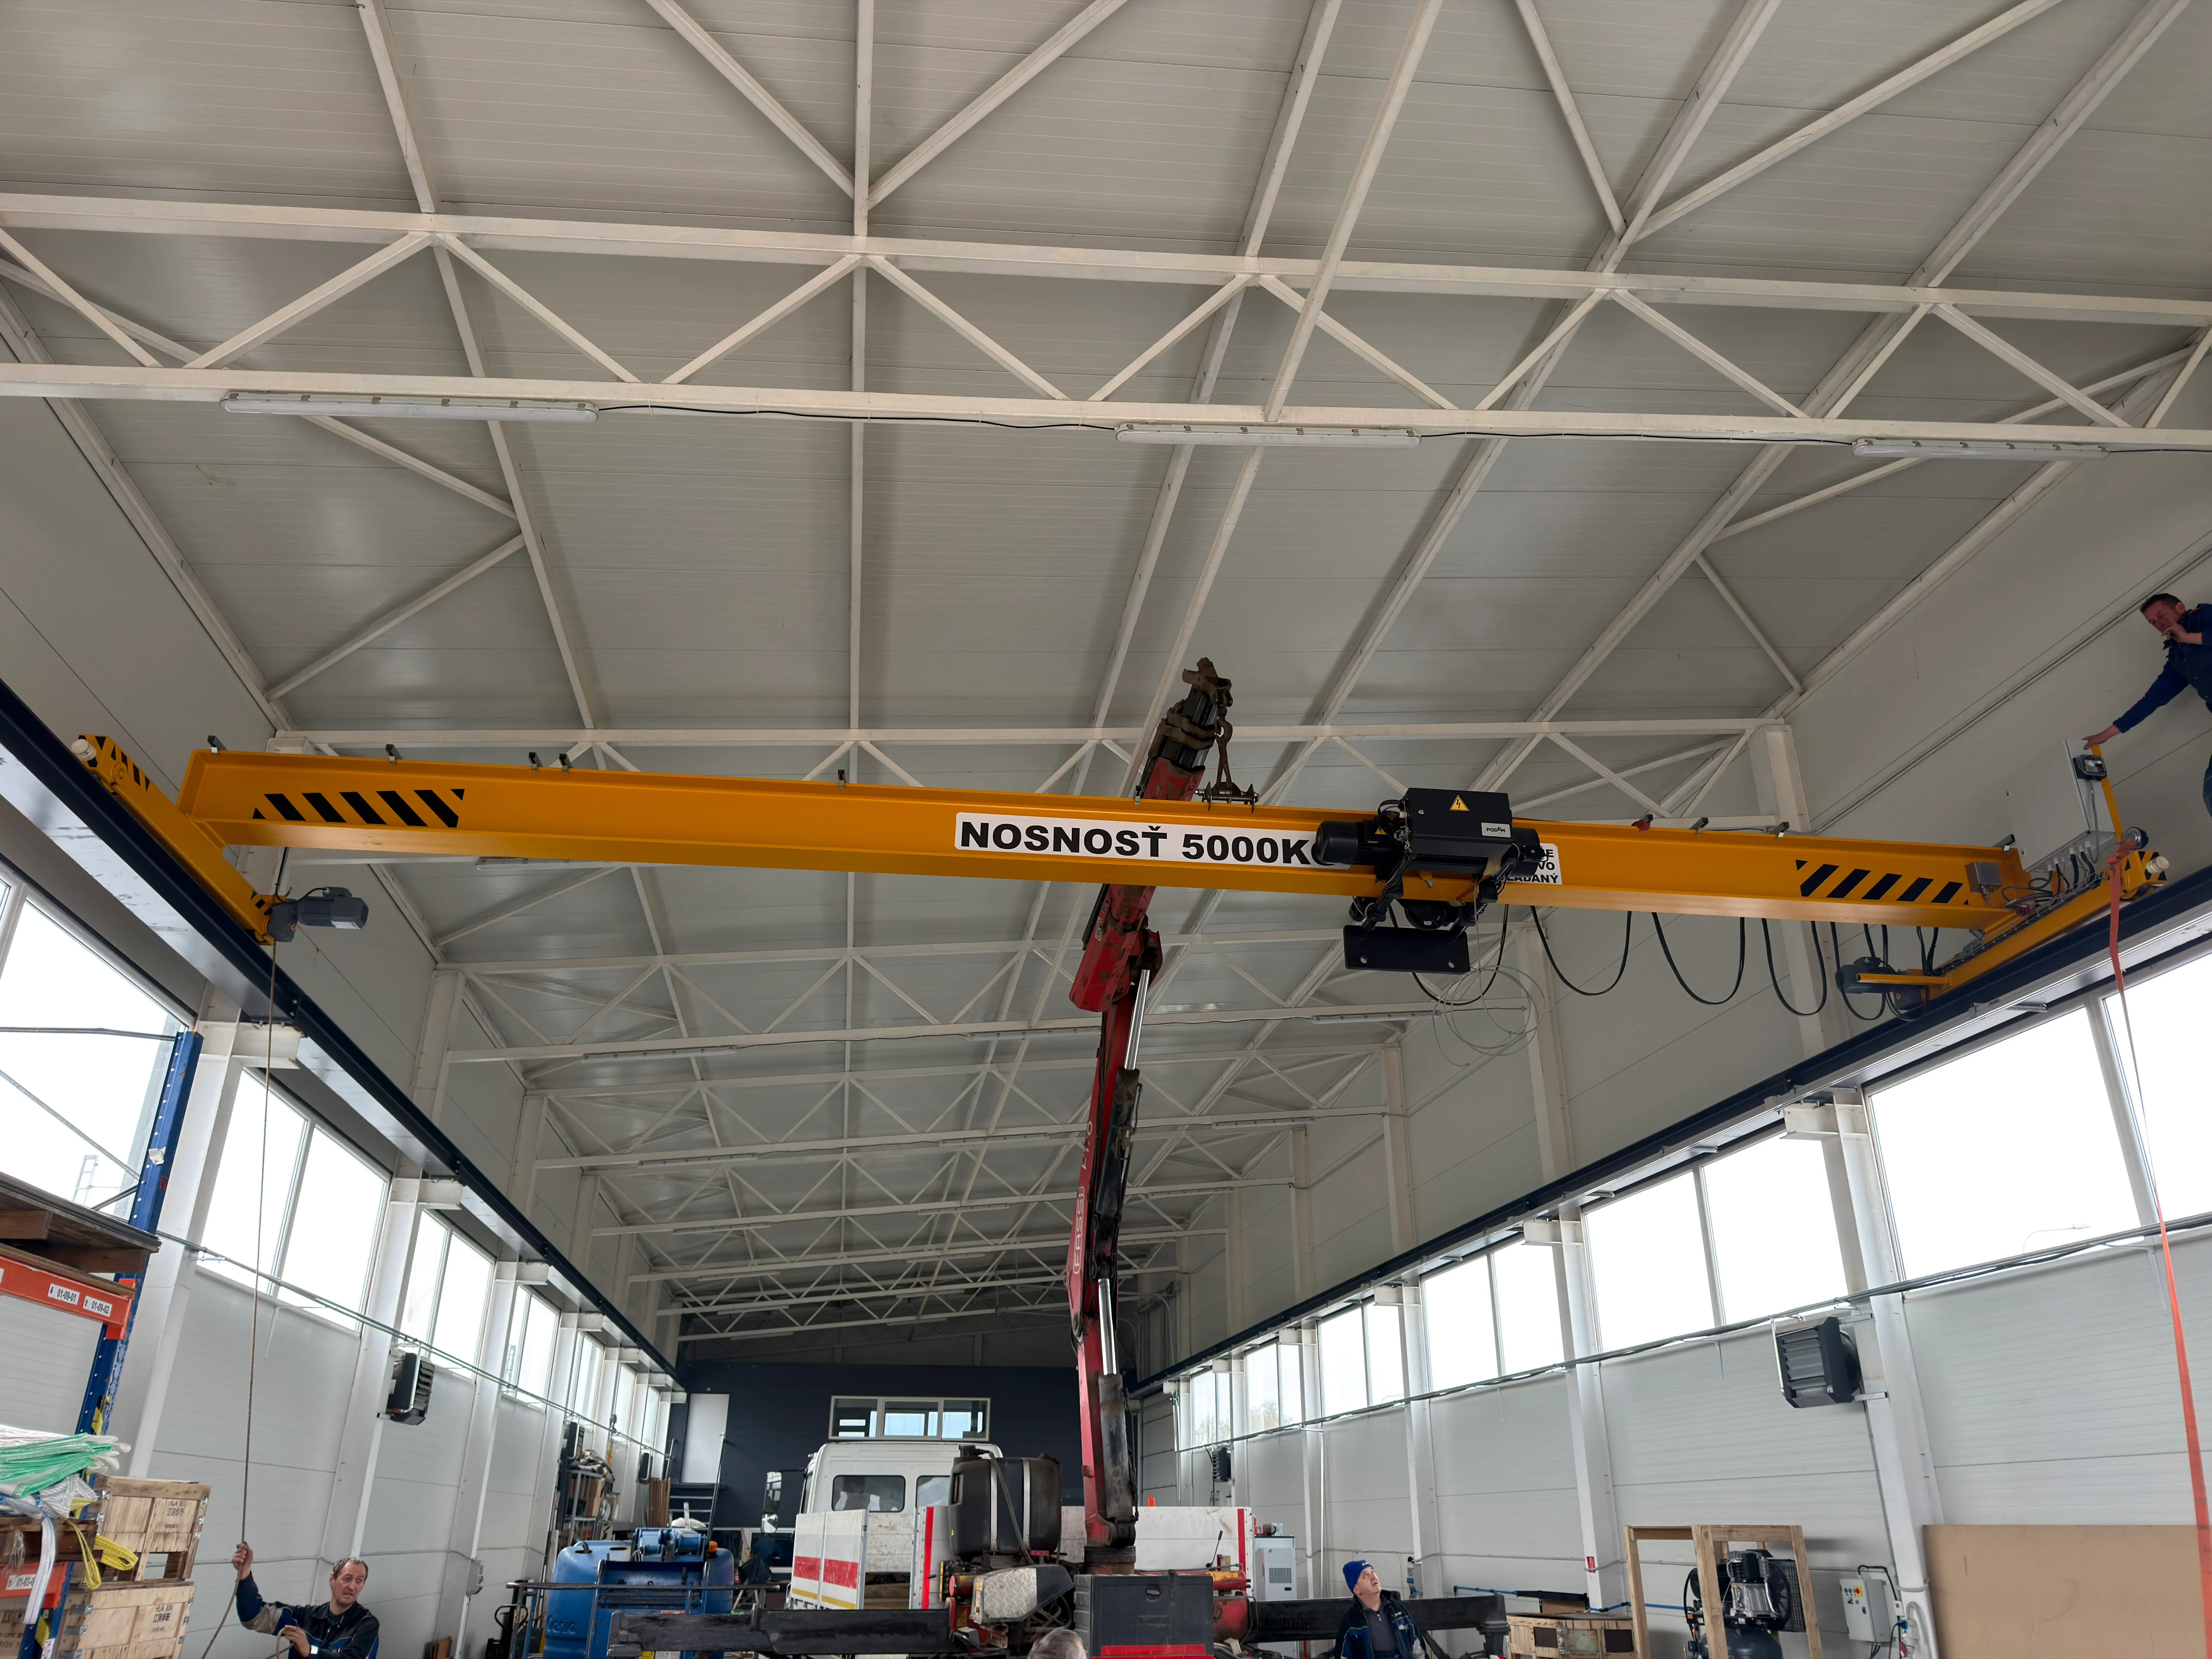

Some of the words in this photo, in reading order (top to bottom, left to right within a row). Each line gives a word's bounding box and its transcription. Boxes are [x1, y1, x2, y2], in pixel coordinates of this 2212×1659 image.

[961, 821, 1167, 858] NOSNOSŤ
[1074, 1193, 1084, 1267] FASSI
[57, 1289, 76, 1302] 01-09-01
[91, 1301, 110, 1314] 01-09-02
[16, 1576, 35, 1587] 01-03-0
